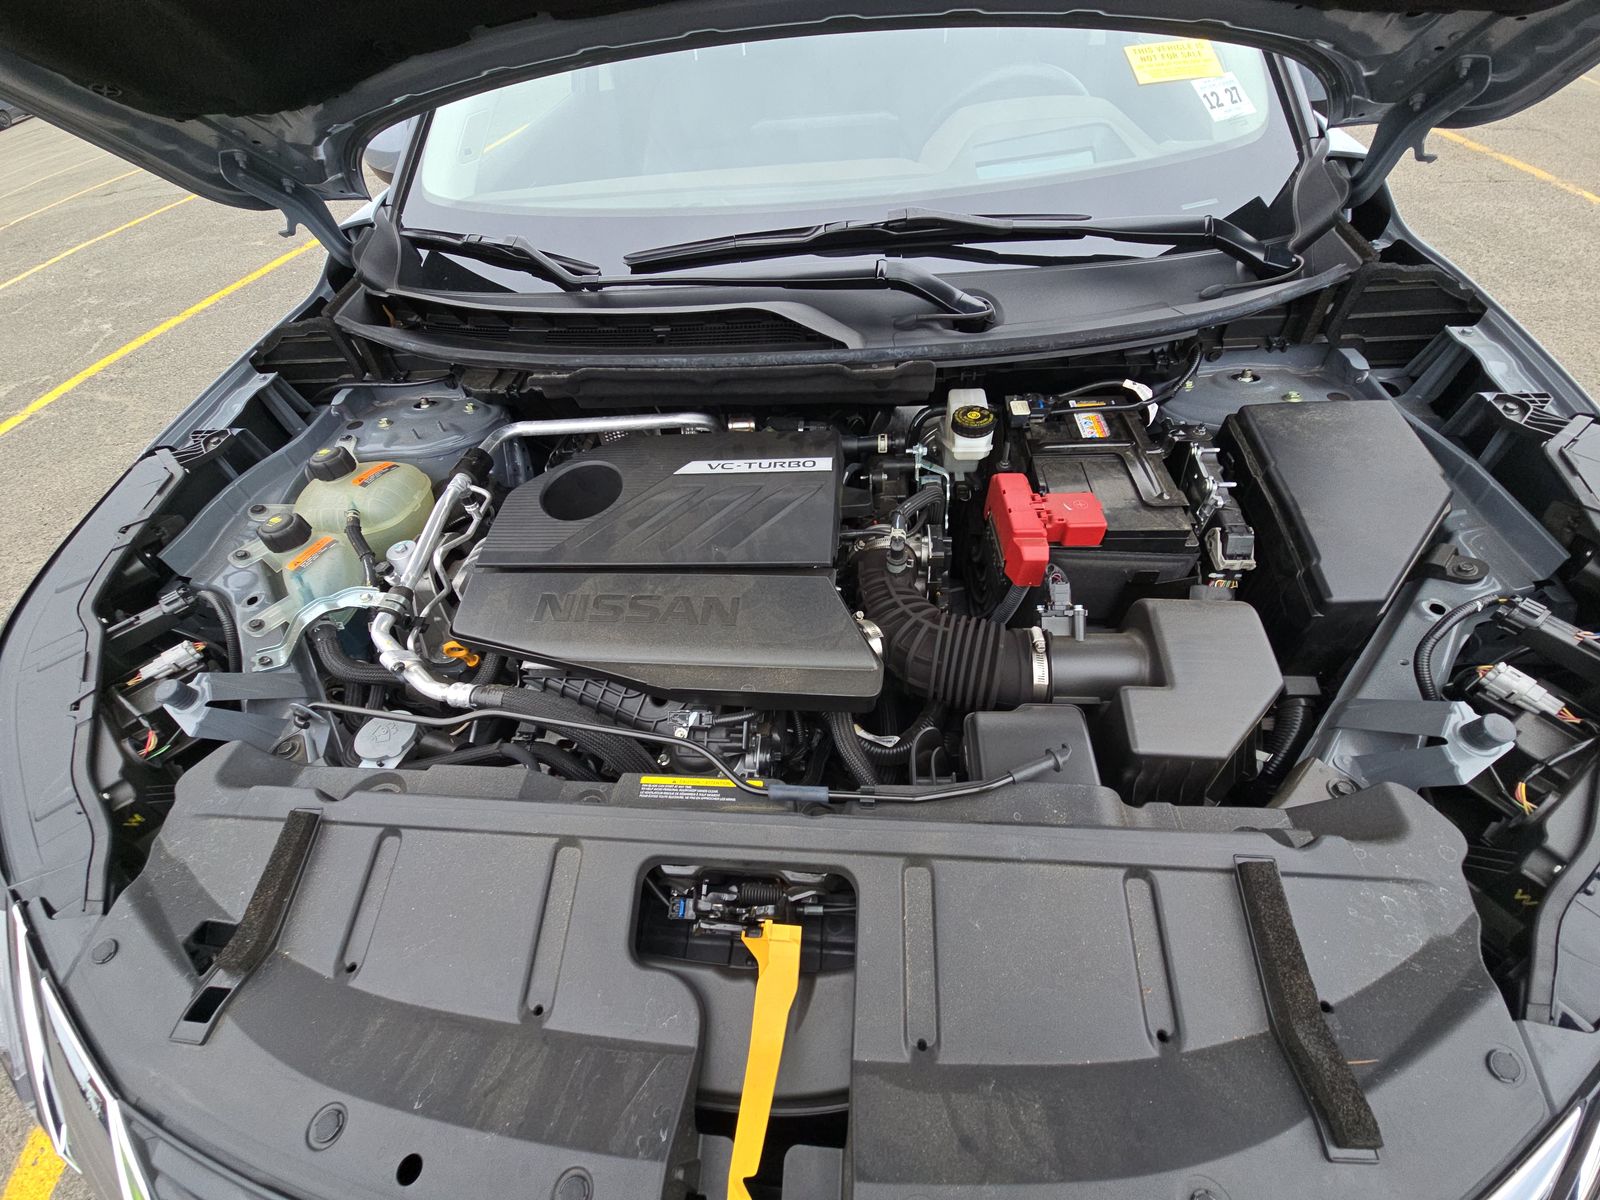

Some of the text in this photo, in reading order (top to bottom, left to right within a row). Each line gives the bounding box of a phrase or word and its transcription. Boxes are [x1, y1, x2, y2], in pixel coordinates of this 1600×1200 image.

[1132, 46, 1154, 55] THIS
[1156, 42, 1192, 53] VEHICLE
[1140, 50, 1203, 63] NOT FOR SALE
[1202, 91, 1225, 110] 12
[1224, 86, 1243, 105] 27
[707, 459, 817, 470] VC-TURBO
[531, 593, 741, 627] NISSAN
